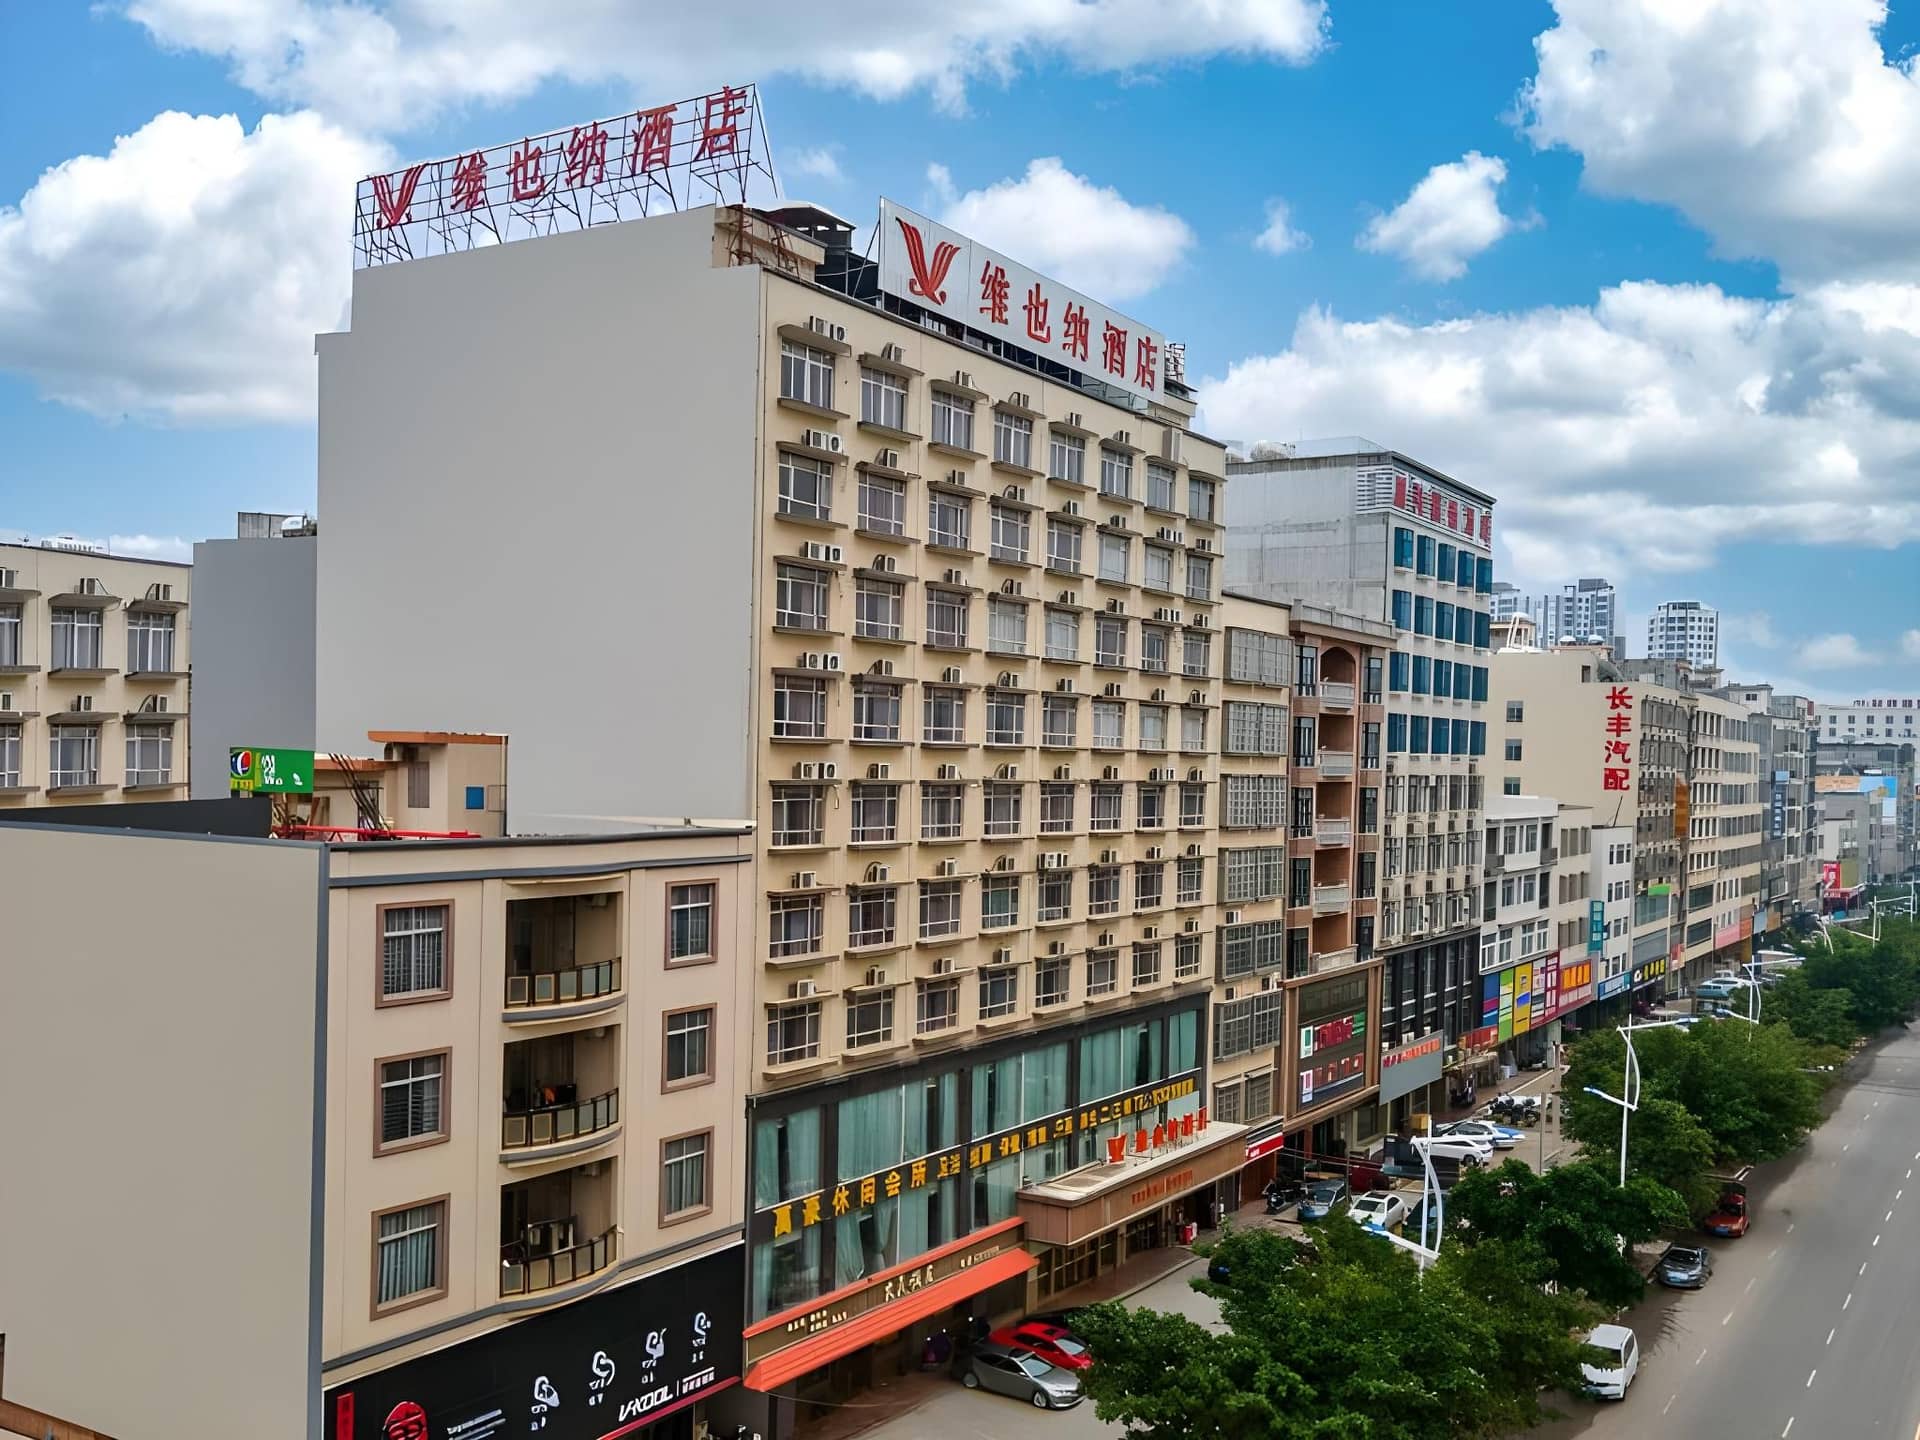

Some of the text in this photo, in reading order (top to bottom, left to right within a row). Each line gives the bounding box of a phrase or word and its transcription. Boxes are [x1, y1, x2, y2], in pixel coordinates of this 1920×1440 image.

[450, 85, 748, 212] 维也纳酒店
[979, 259, 1158, 391] 维也纳酒店
[1603, 685, 1633, 791] 长丰汽配
